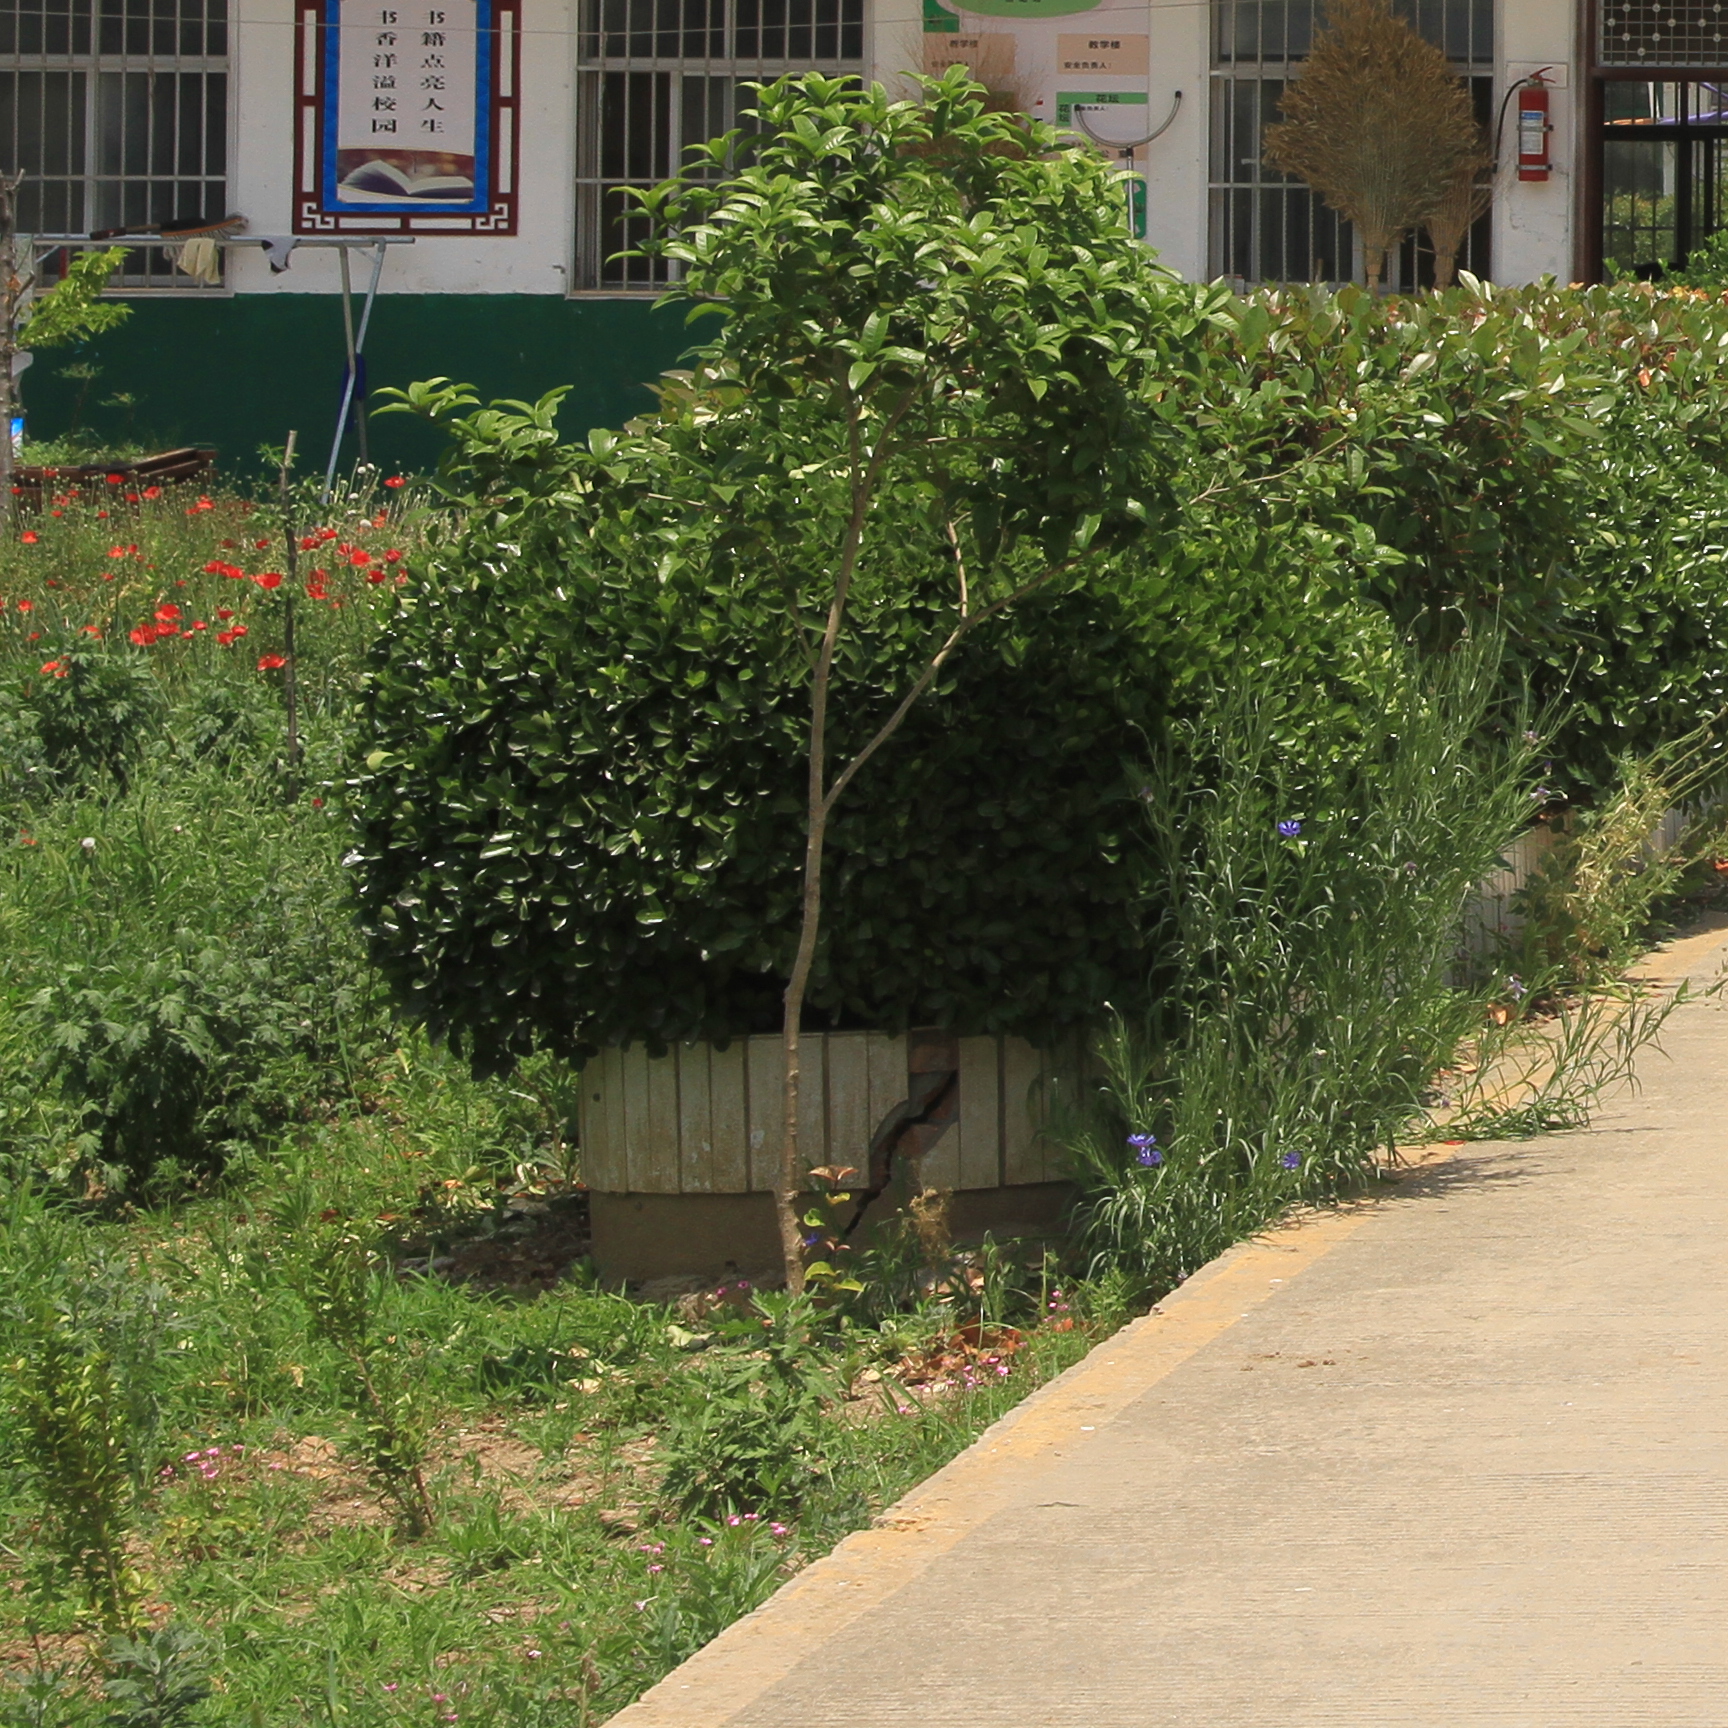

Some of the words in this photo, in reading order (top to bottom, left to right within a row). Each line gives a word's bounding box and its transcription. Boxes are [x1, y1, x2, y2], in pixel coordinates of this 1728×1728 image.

[371, 10, 398, 133] 书香洋溢校园
[420, 10, 446, 133] 书籍点亮人生
[1088, 40, 1121, 49] 教学楼
[1096, 94, 1119, 103] 花坛
